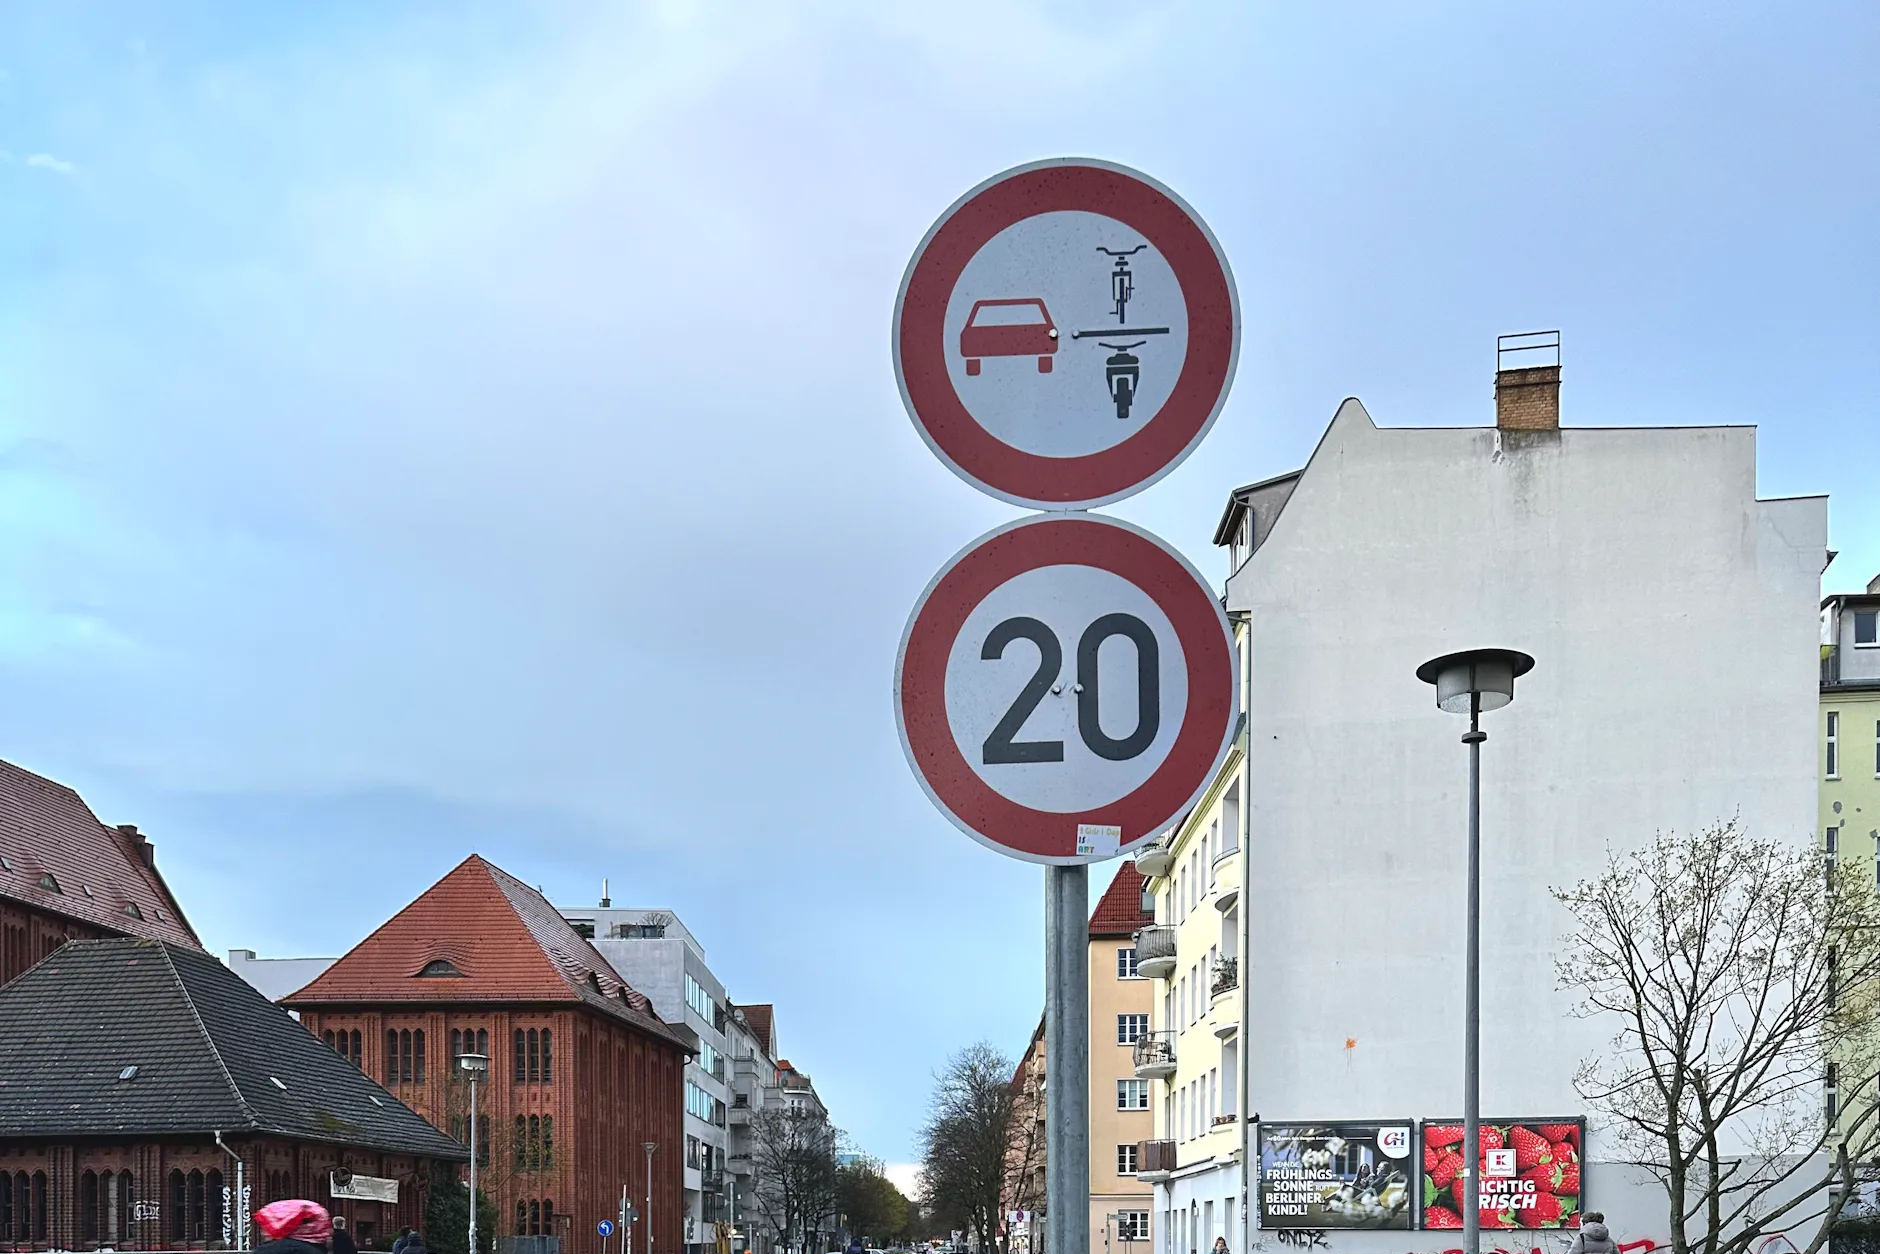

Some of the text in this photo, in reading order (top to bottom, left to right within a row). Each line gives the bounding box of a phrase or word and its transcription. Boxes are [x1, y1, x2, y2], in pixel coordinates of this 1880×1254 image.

[981, 612, 1160, 765] 20
[1266, 1167, 1337, 1180] FRÜHLINGS-
[1274, 1180, 1314, 1192] SONNE
[1479, 1180, 1536, 1193] ICHTIG
[1478, 1193, 1538, 1210] RISCH
[1268, 1205, 1309, 1216] KINDL!
